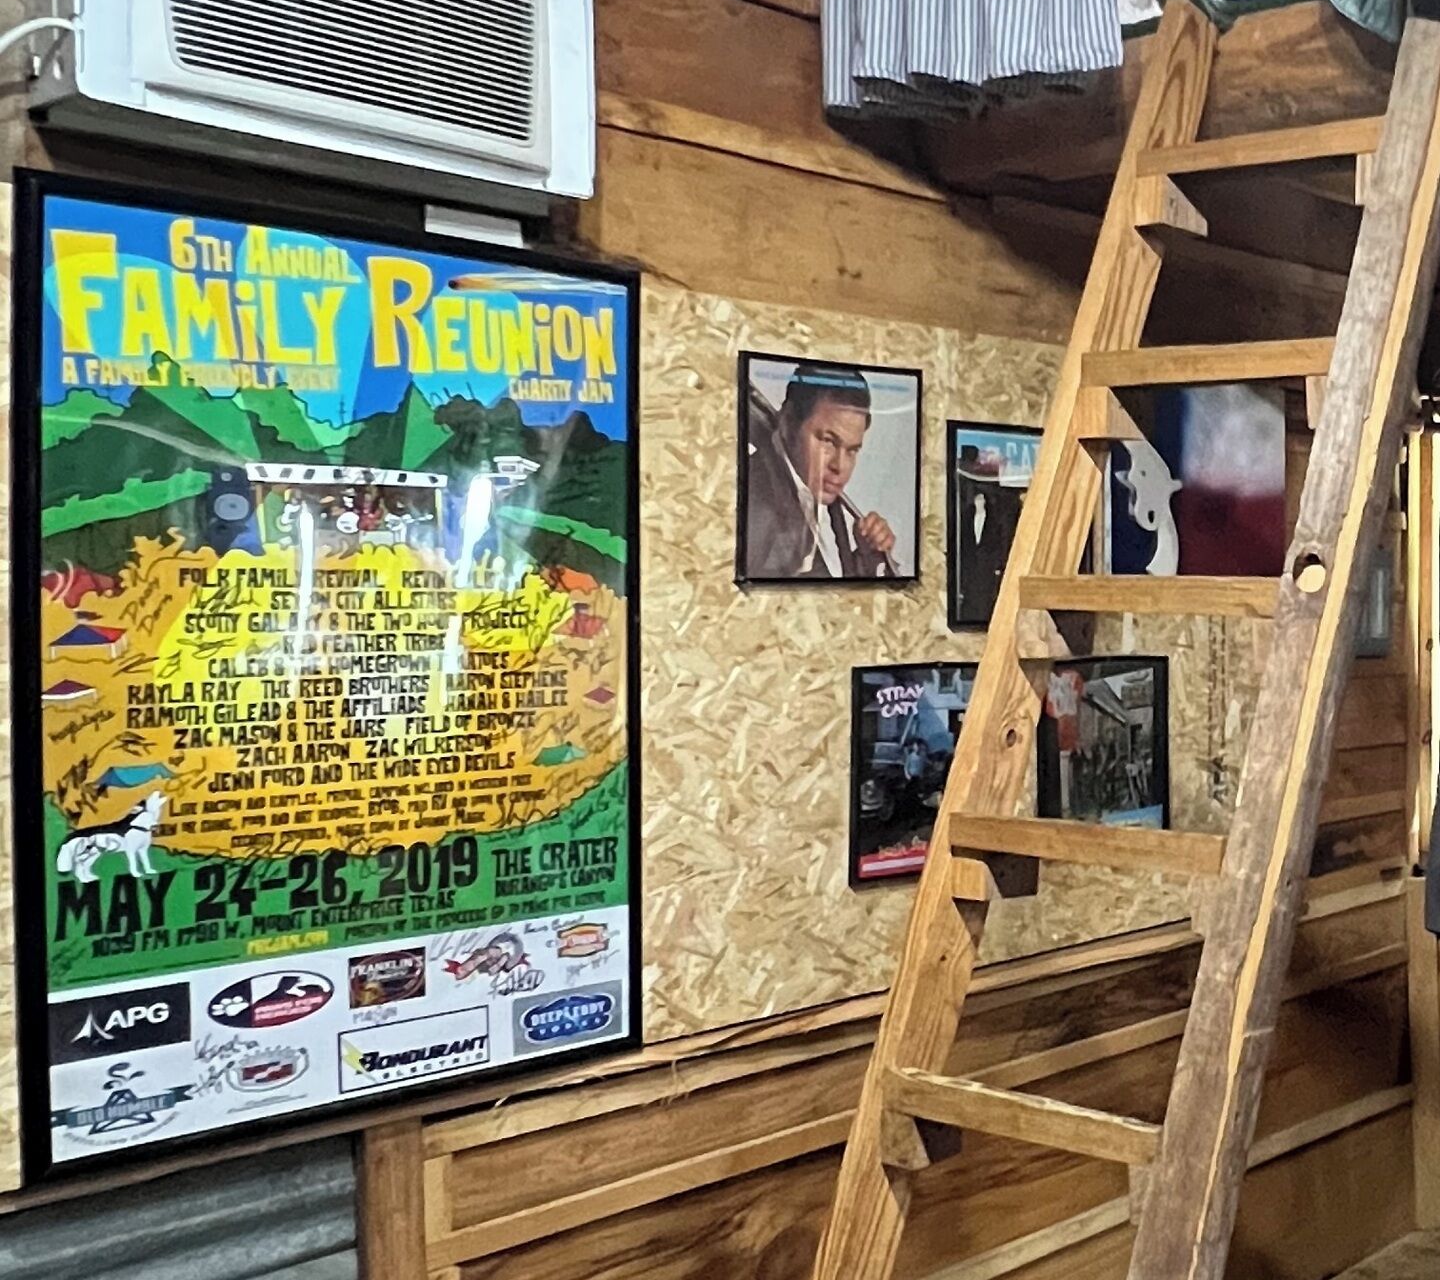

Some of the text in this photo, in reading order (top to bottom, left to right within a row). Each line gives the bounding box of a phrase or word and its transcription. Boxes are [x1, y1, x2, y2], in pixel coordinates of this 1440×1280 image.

[169, 216, 361, 284] 6TH ANNUAL
[62, 356, 79, 384] A
[578, 381, 614, 404] JAM
[346, 612, 376, 631] THE
[208, 658, 268, 679] CALEB
[260, 679, 290, 699] THE
[299, 677, 343, 697] REED
[349, 674, 430, 697] BROTHERS
[876, 683, 925, 704] STRAY
[126, 706, 207, 730] RAMOTH
[303, 699, 336, 720] THE
[880, 700, 918, 719] CATS
[173, 727, 213, 750] ZAC
[218, 724, 282, 747] MASON
[303, 722, 336, 741] THE
[341, 718, 387, 739] JARS
[405, 716, 451, 735] FIELD
[236, 746, 287, 769] ZACH
[292, 742, 351, 765] AARON
[365, 738, 399, 759] ZAC
[208, 770, 255, 794] JENN
[261, 767, 306, 790] FORD
[311, 764, 343, 785] AND
[348, 761, 378, 782] THE
[426, 755, 462, 775] EYED
[492, 836, 619, 878] THE CRATER
[55, 835, 479, 943] MAY 24-26, 2019
[141, 929, 170, 952] FM
[104, 1001, 170, 1031] APG
[531, 1008, 565, 1026] DEEP
